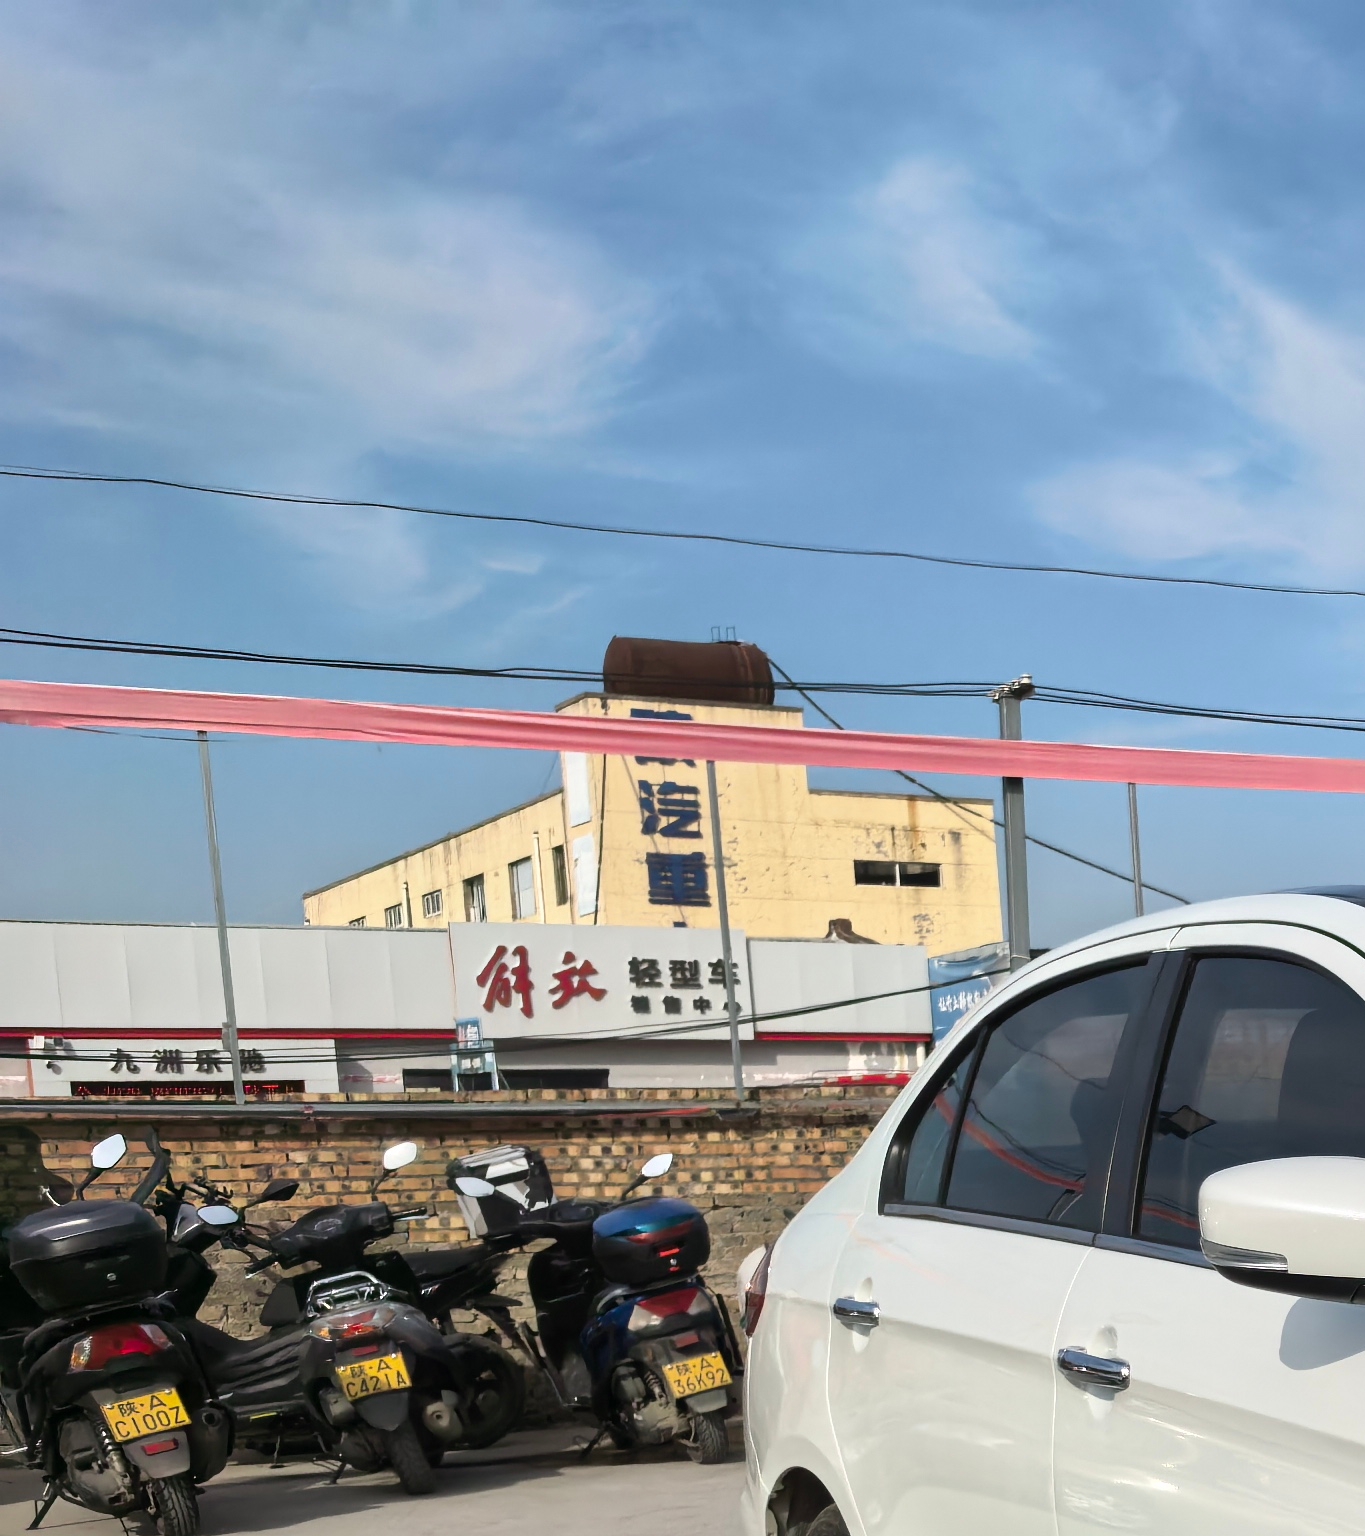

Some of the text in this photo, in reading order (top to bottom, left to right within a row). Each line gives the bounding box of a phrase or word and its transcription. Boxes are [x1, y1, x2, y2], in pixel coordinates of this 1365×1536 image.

[476, 945, 607, 1018] 解放
[628, 957, 740, 989] 轻型车
[346, 1370, 407, 1397] C421A
[674, 1368, 728, 1394] 36K92
[115, 1406, 186, 1437] C100Z
